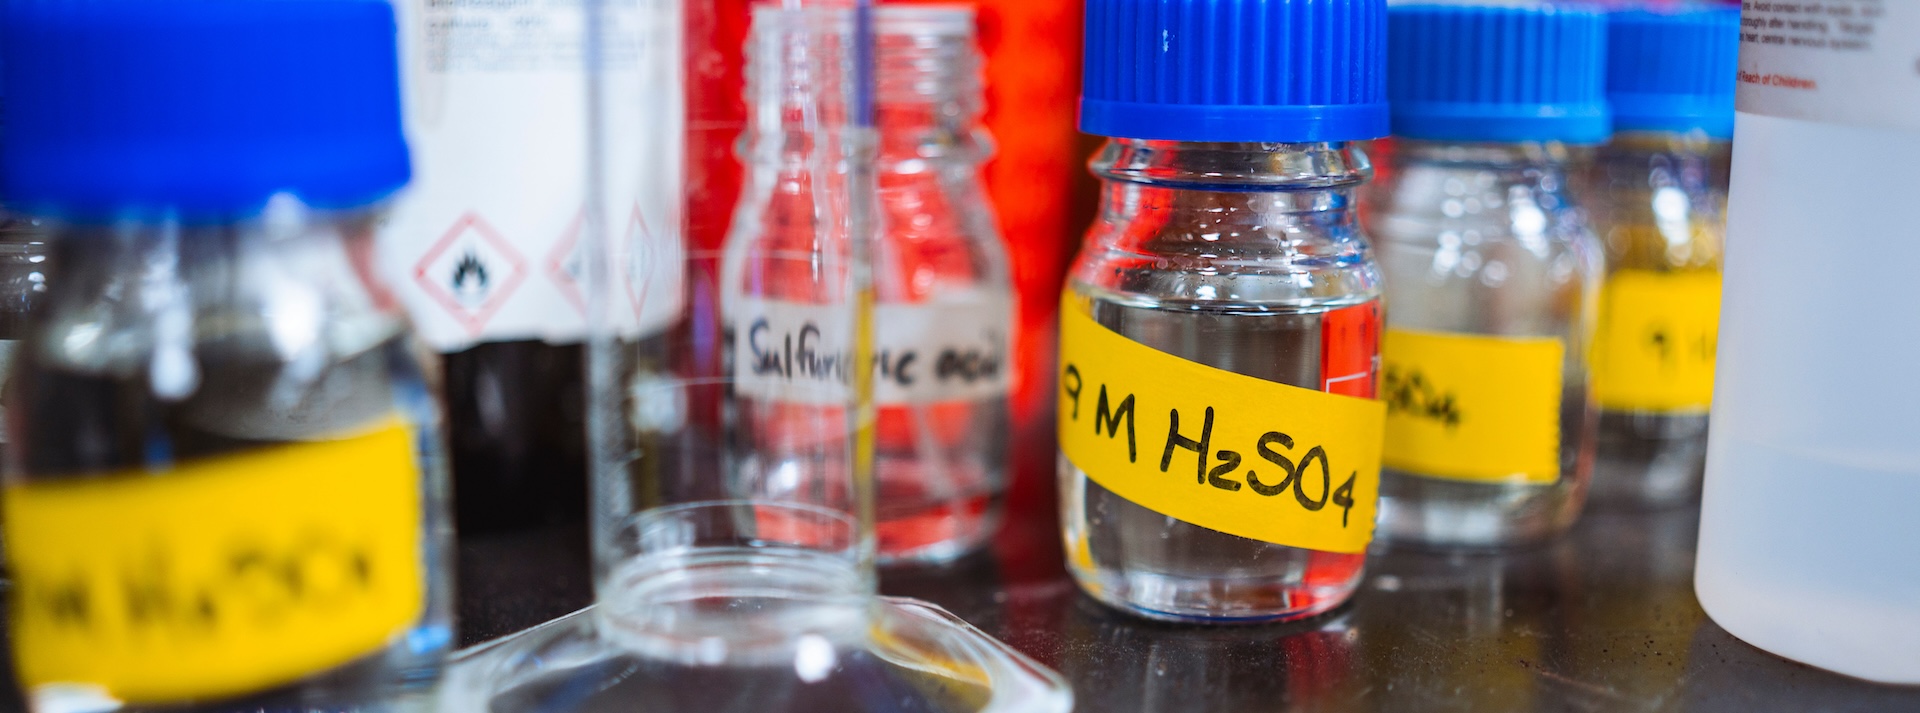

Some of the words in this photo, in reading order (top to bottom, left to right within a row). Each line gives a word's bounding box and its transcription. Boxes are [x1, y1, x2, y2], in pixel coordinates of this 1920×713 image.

[1065, 363, 1083, 421] 9
[1096, 383, 1137, 464] M
[1159, 405, 1357, 529] H2SO4
